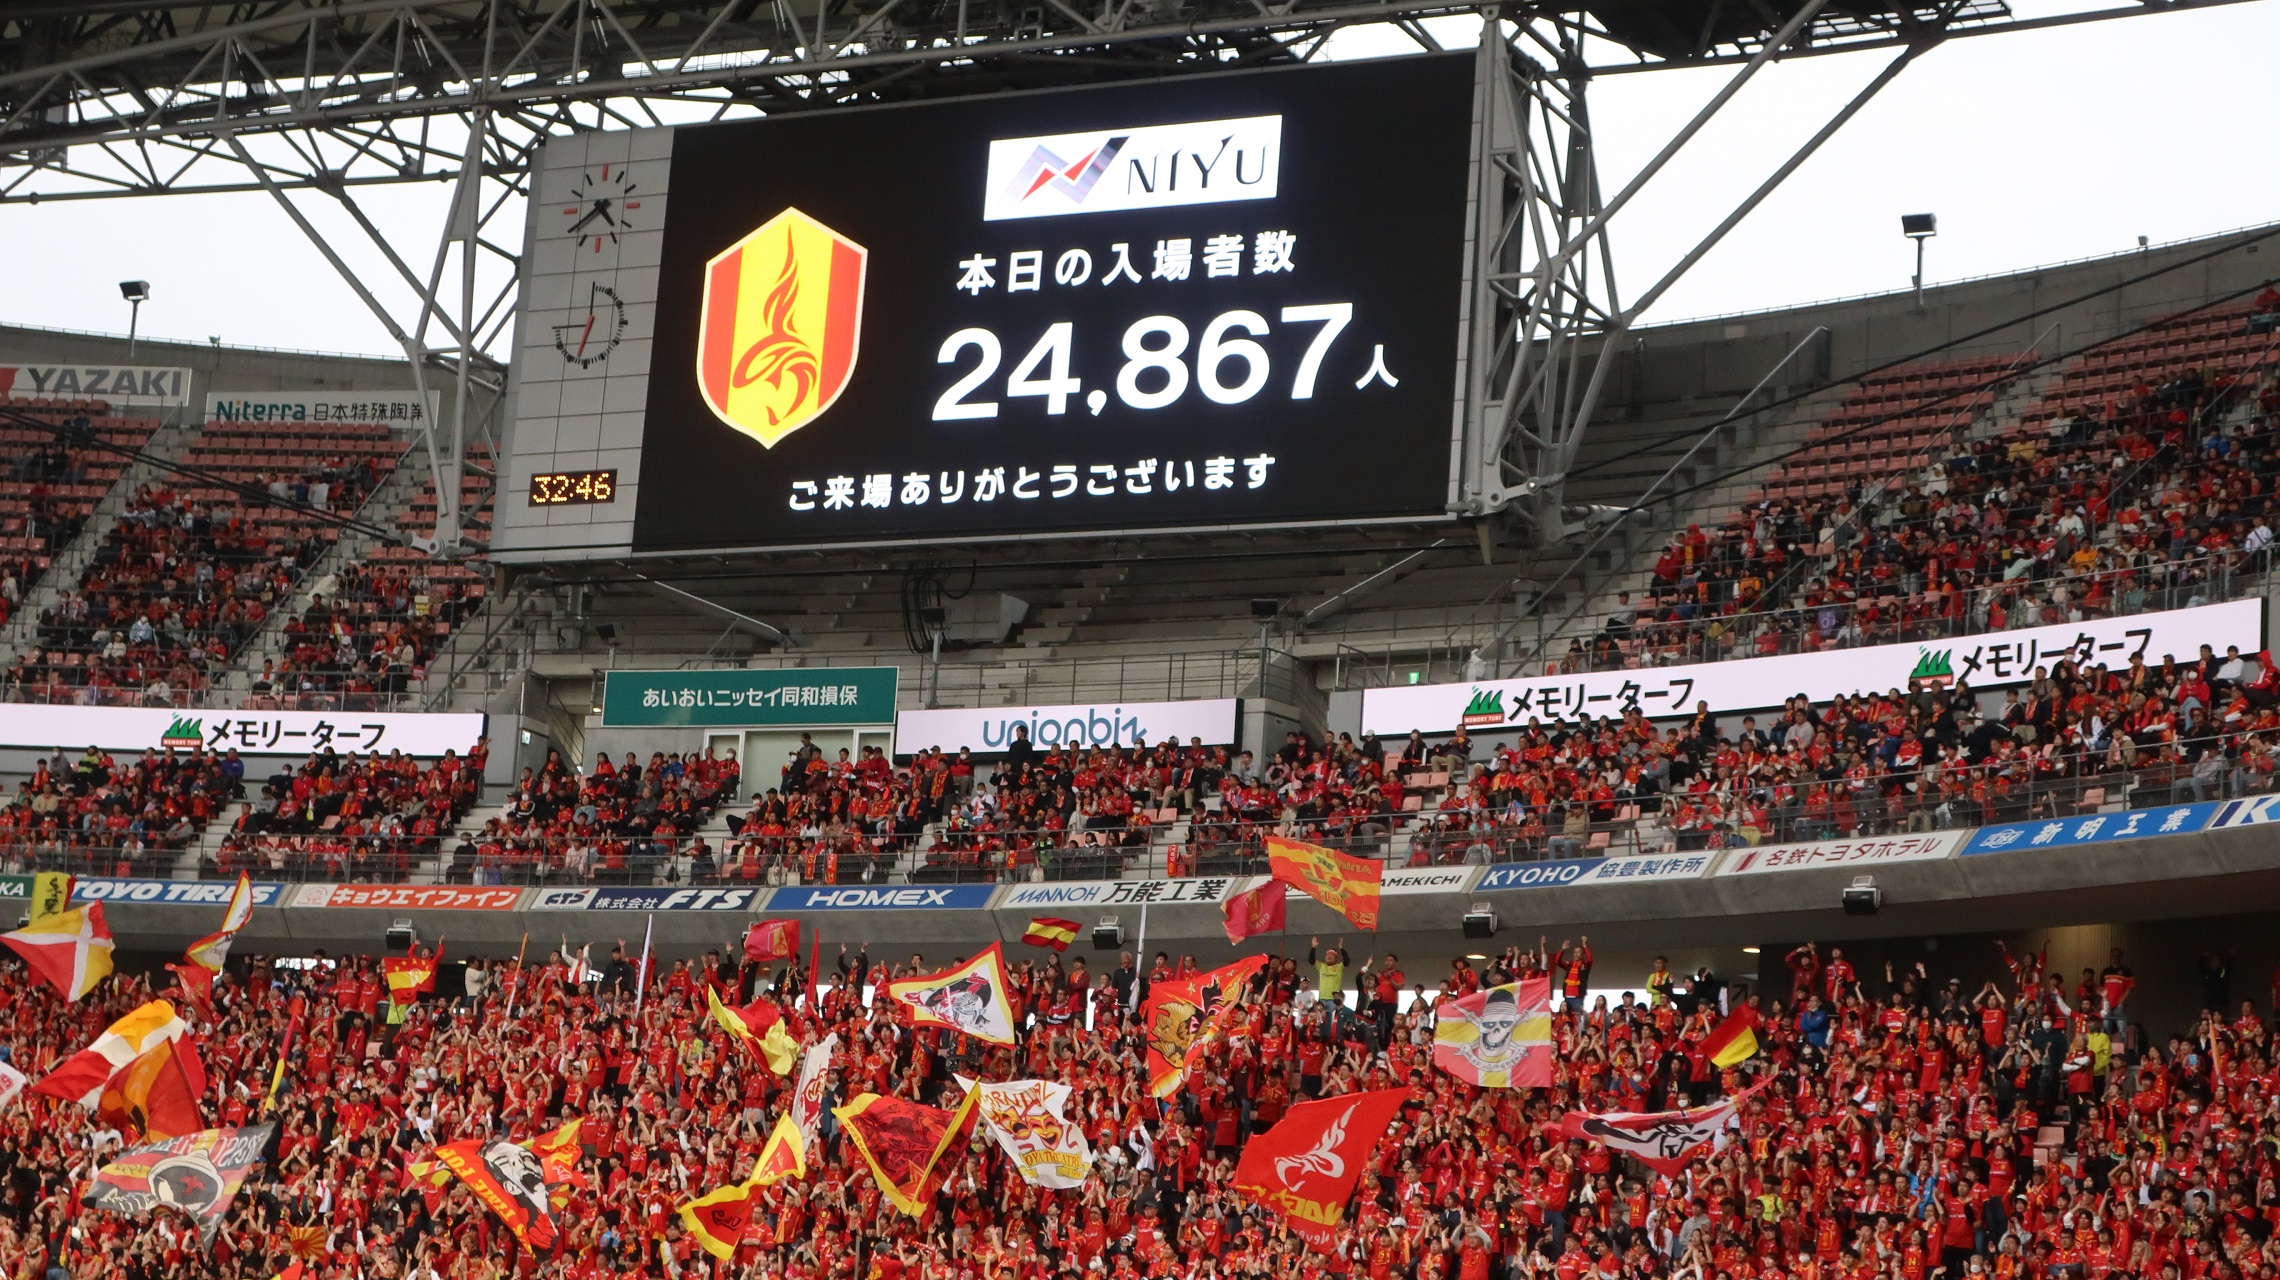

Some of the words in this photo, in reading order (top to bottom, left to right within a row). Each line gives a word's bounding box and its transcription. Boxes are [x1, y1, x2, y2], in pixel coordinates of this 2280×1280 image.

[1129, 132, 1270, 195] NIYU
[956, 229, 1297, 296] 本日の入場者数
[932, 302, 1353, 421] 24,867
[1355, 344, 1399, 390] 人
[28, 367, 183, 397] YAZAKI
[216, 400, 306, 421] Niterra
[313, 402, 423, 421] 日本特殊陶業
[533, 473, 611, 503] 32:46
[788, 453, 1276, 511] ご来場ありがとうございます
[642, 686, 858, 707] あいおいニッセイ同和損保
[1509, 679, 1694, 721] メモリーターフ
[207, 718, 386, 750] メモリーターフ
[2031, 808, 2192, 845] 新明工業
[1765, 837, 1943, 867] 名鉄トヨタホテル
[1483, 865, 1581, 886] KYOHO
[1597, 856, 1707, 878] 協豊製作所
[71, 881, 167, 900] TOYO
[332, 888, 516, 908] キョウエイファイン
[595, 897, 658, 910] 株式会社
[658, 889, 753, 909] FTS
[806, 889, 953, 907] HOMEX
[1009, 886, 1101, 904] MANNOH
[1101, 878, 1228, 903] 万能工業
